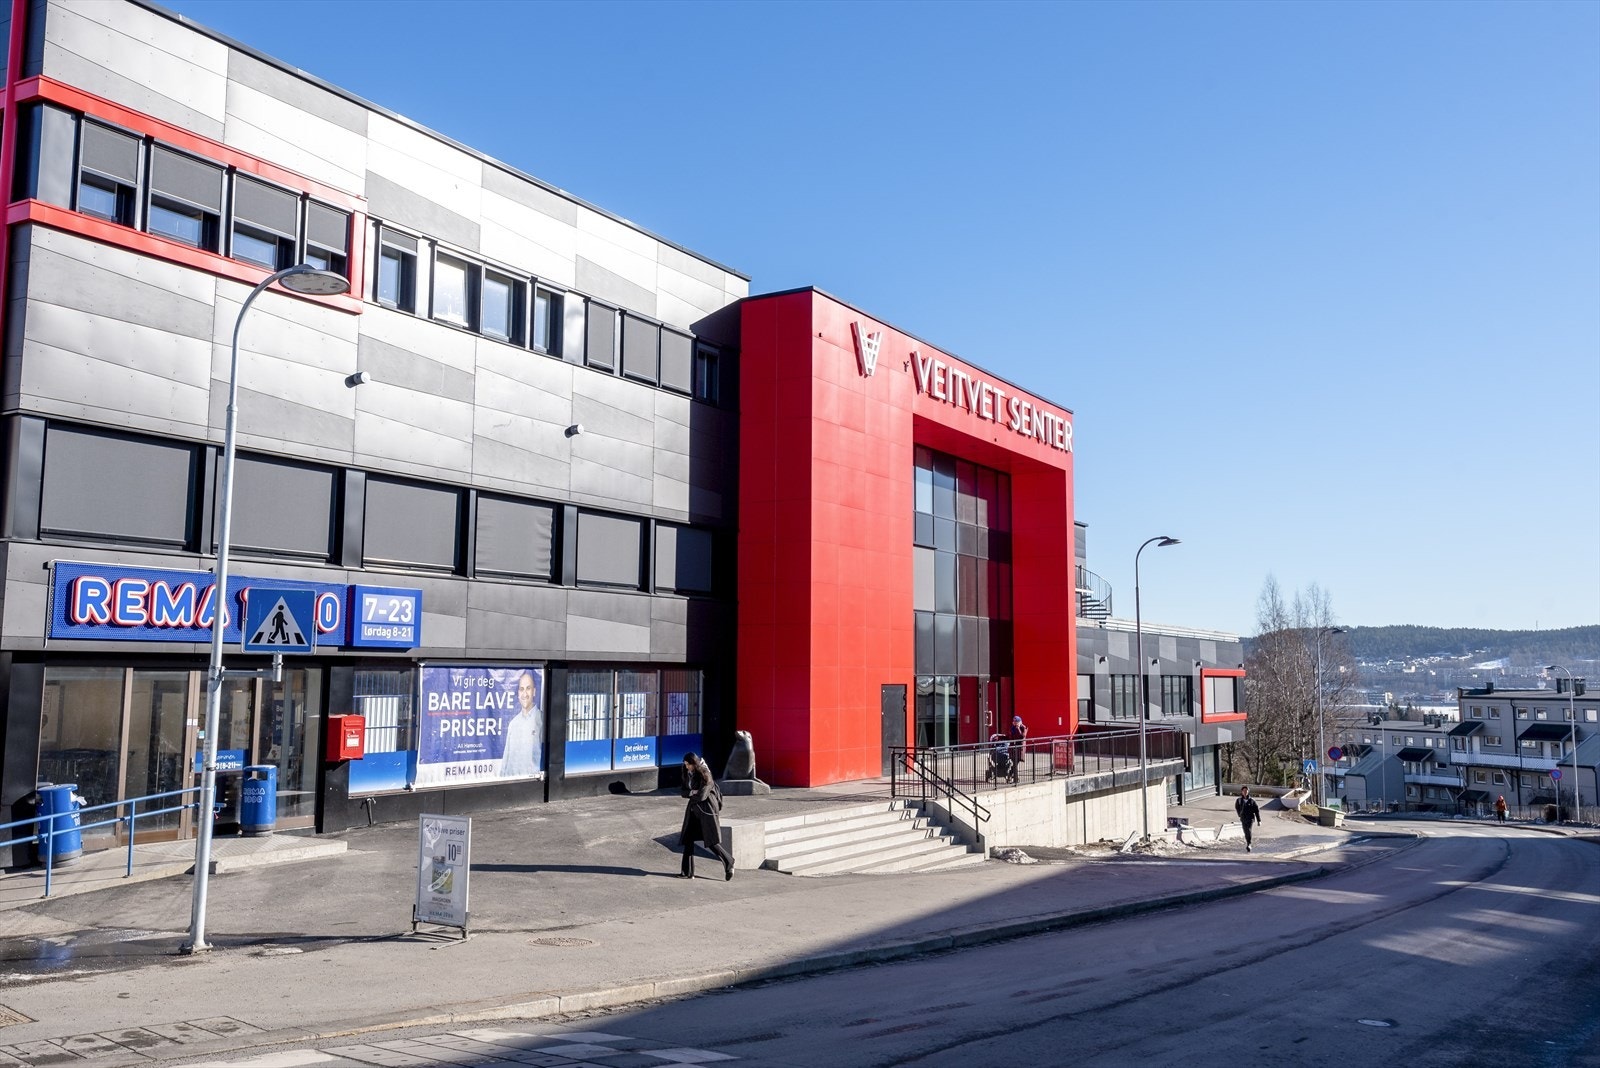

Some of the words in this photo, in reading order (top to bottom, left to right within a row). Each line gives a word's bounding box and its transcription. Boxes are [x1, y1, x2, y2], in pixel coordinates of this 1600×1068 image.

[911, 351, 1005, 423] VEITVET
[1008, 396, 1073, 453] SENTER
[365, 597, 412, 622] 7-23
[364, 626, 391, 638] lørdag
[392, 627, 411, 637] 8-21
[452, 675, 462, 687] Vi
[463, 675, 476, 689] gir
[478, 675, 495, 688] deg
[428, 692, 470, 710] BARE
[476, 692, 514, 709] LAVE
[440, 718, 502, 737] PRISER!
[445, 765, 472, 776] REMA
[473, 764, 493, 774] 1000
